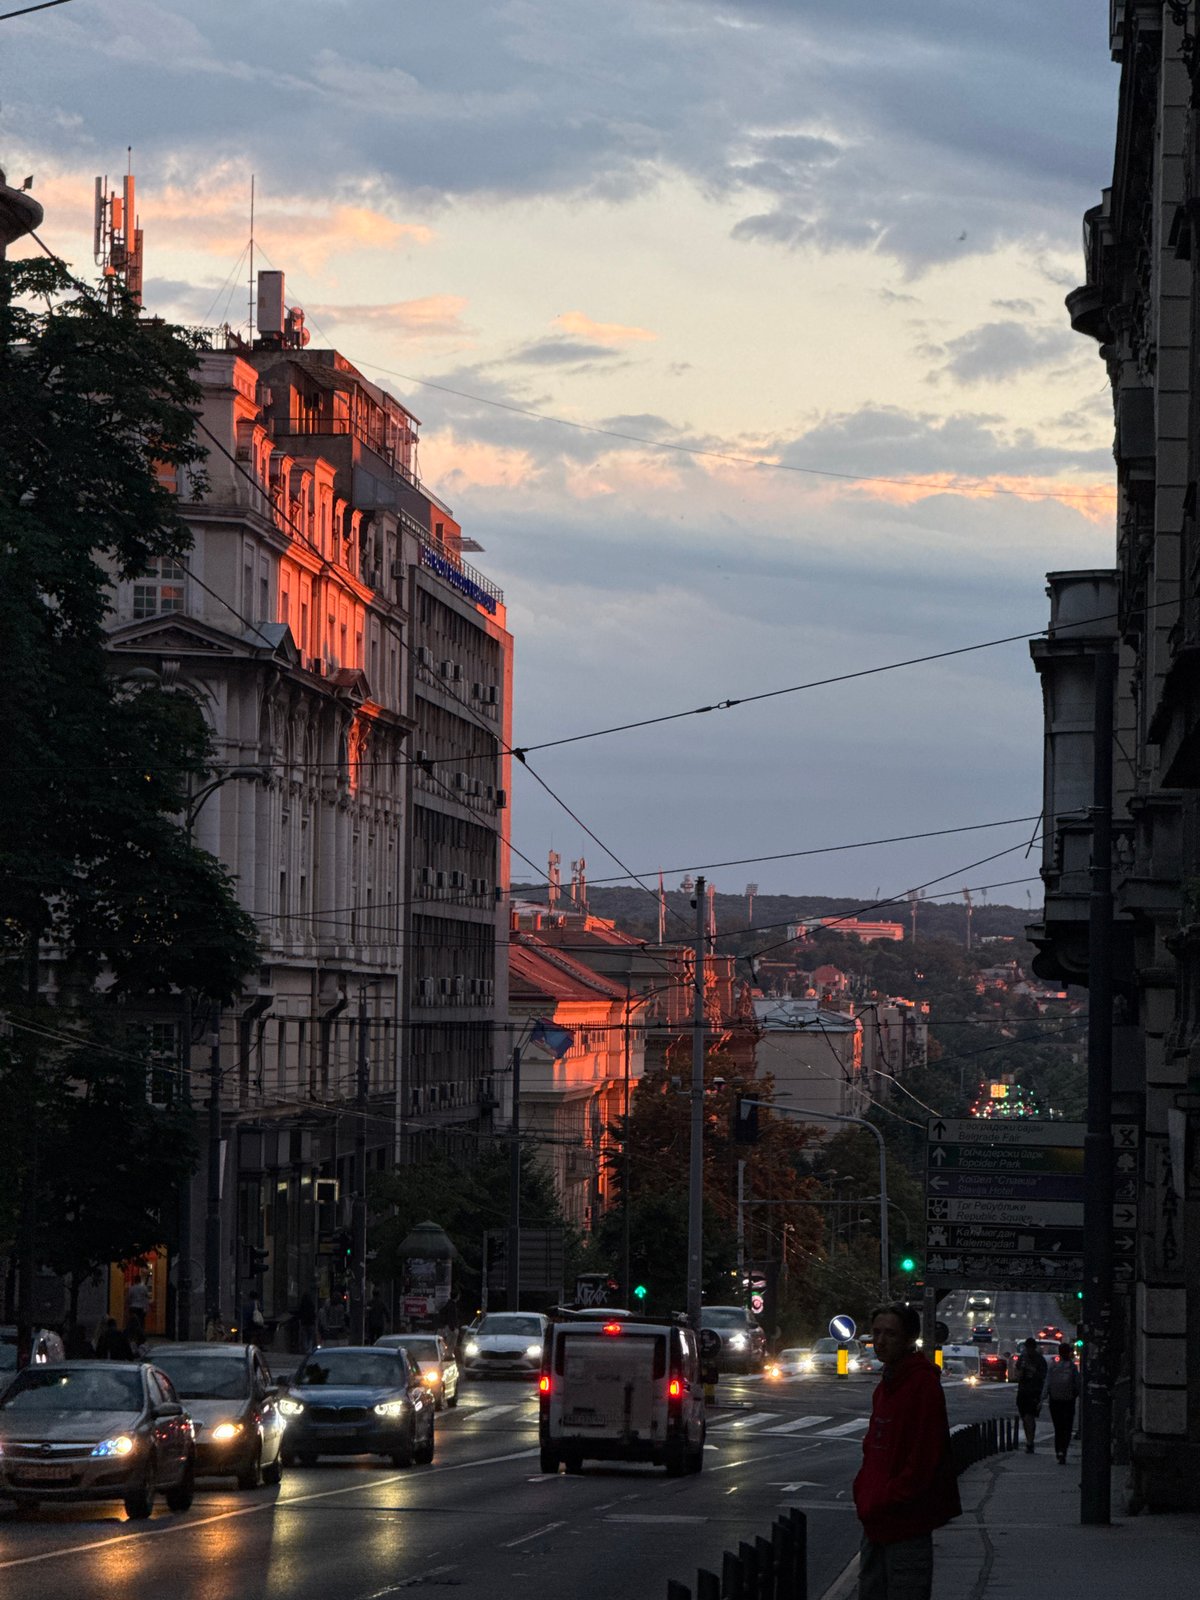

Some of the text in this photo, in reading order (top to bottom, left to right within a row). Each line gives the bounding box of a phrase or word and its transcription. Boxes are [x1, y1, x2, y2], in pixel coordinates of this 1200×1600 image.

[958, 1131, 1022, 1142] Belgrade Fair
[999, 1159, 1021, 1169] Park
[989, 1186, 1014, 1196] Hotel
[956, 1211, 1033, 1224] Republic Square
